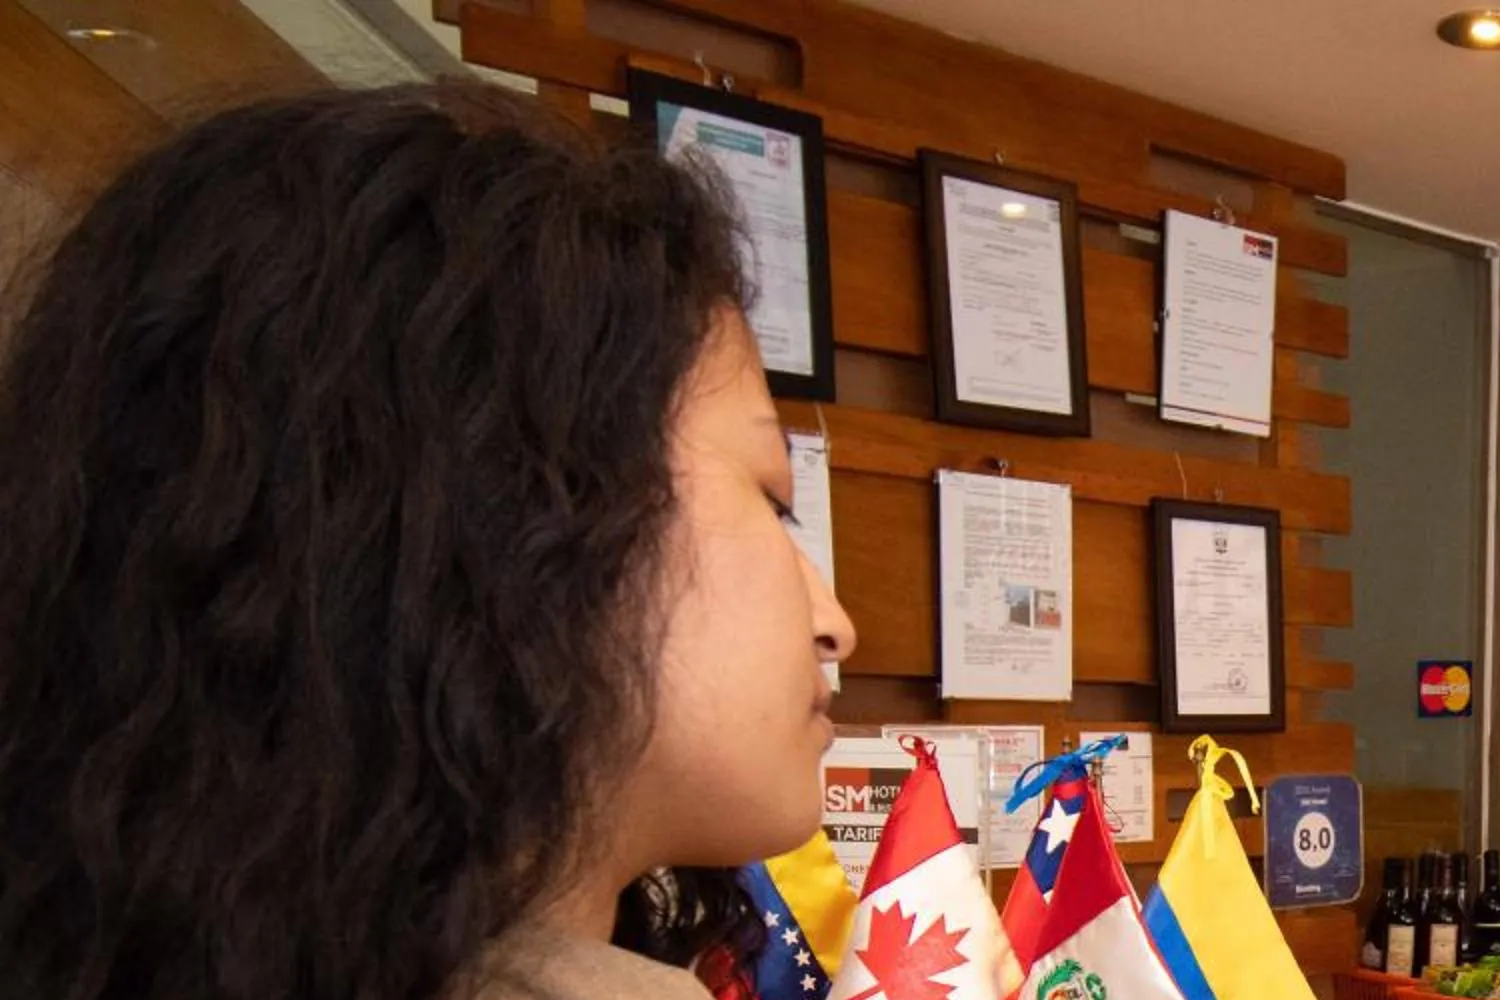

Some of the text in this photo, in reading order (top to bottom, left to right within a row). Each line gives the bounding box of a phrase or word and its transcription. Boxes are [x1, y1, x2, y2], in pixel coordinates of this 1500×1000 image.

[827, 785, 869, 812] SM
[868, 785, 901, 799] HOT
[833, 827, 883, 841] TARIF
